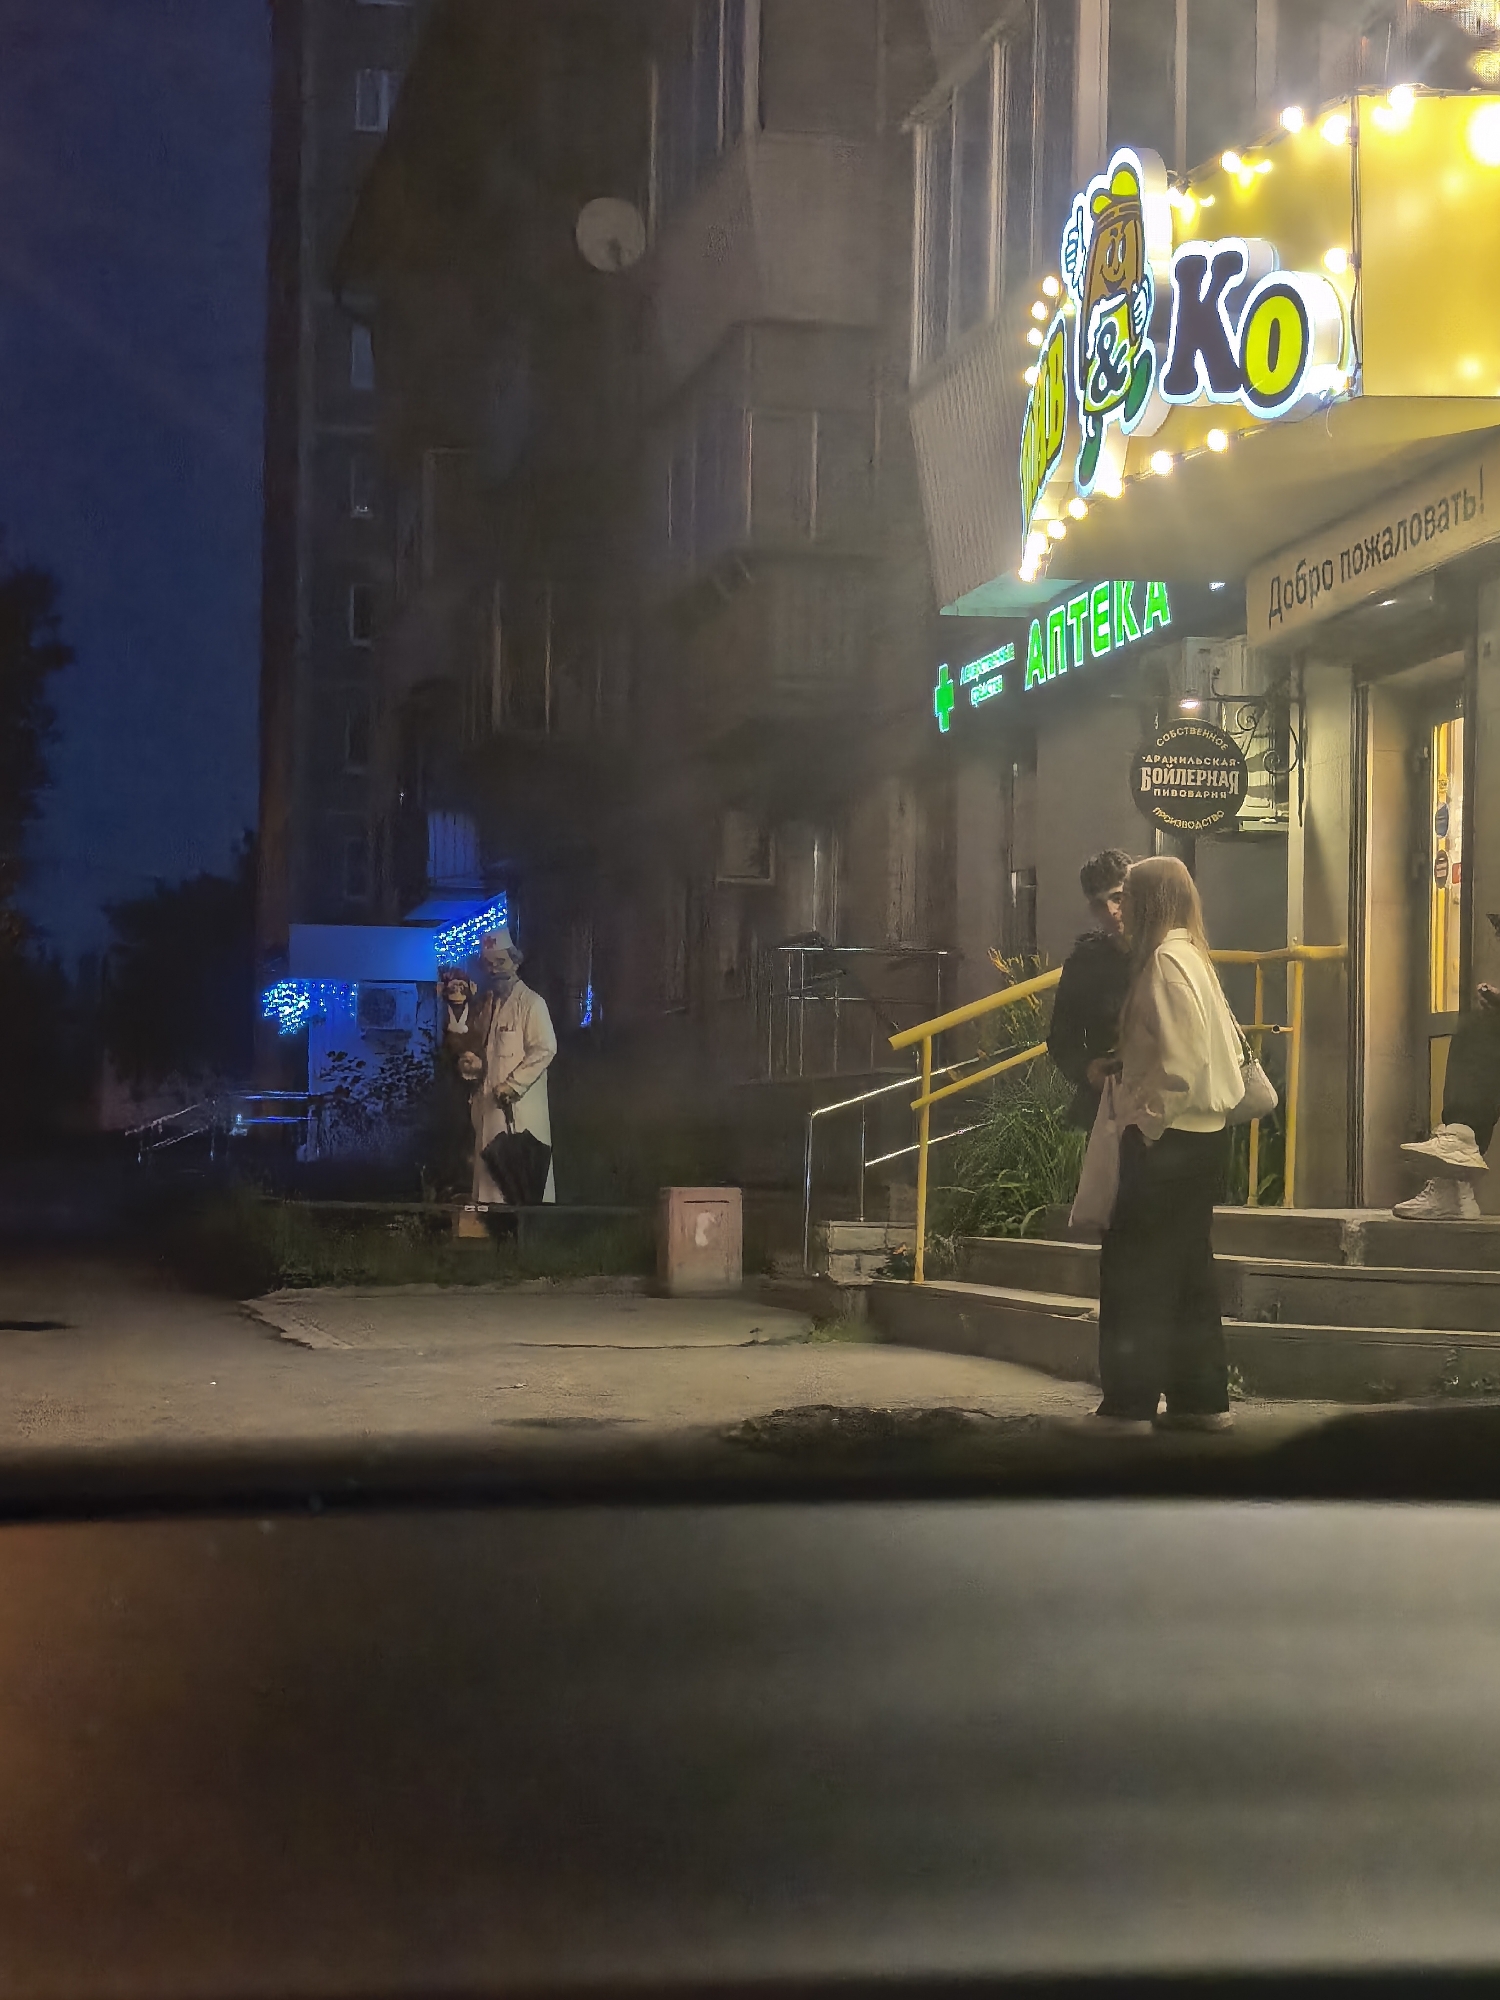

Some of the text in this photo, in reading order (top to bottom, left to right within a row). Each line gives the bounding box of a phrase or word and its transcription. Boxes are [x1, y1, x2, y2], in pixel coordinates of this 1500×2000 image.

[1268, 463, 1486, 630] Добро пожаловать!
[1024, 580, 1172, 691] АПТЕКА
[1156, 726, 1229, 751] СОБСТВЕННОЕ
[1143, 754, 1237, 766] АРАМИЛЬСКАЯ
[1140, 764, 1240, 795] БОЙЛЕРНАЯ
[1153, 787, 1227, 799] ПИВОВАРНЯ
[1152, 806, 1226, 830] ПРОИЗВОДСТВО
